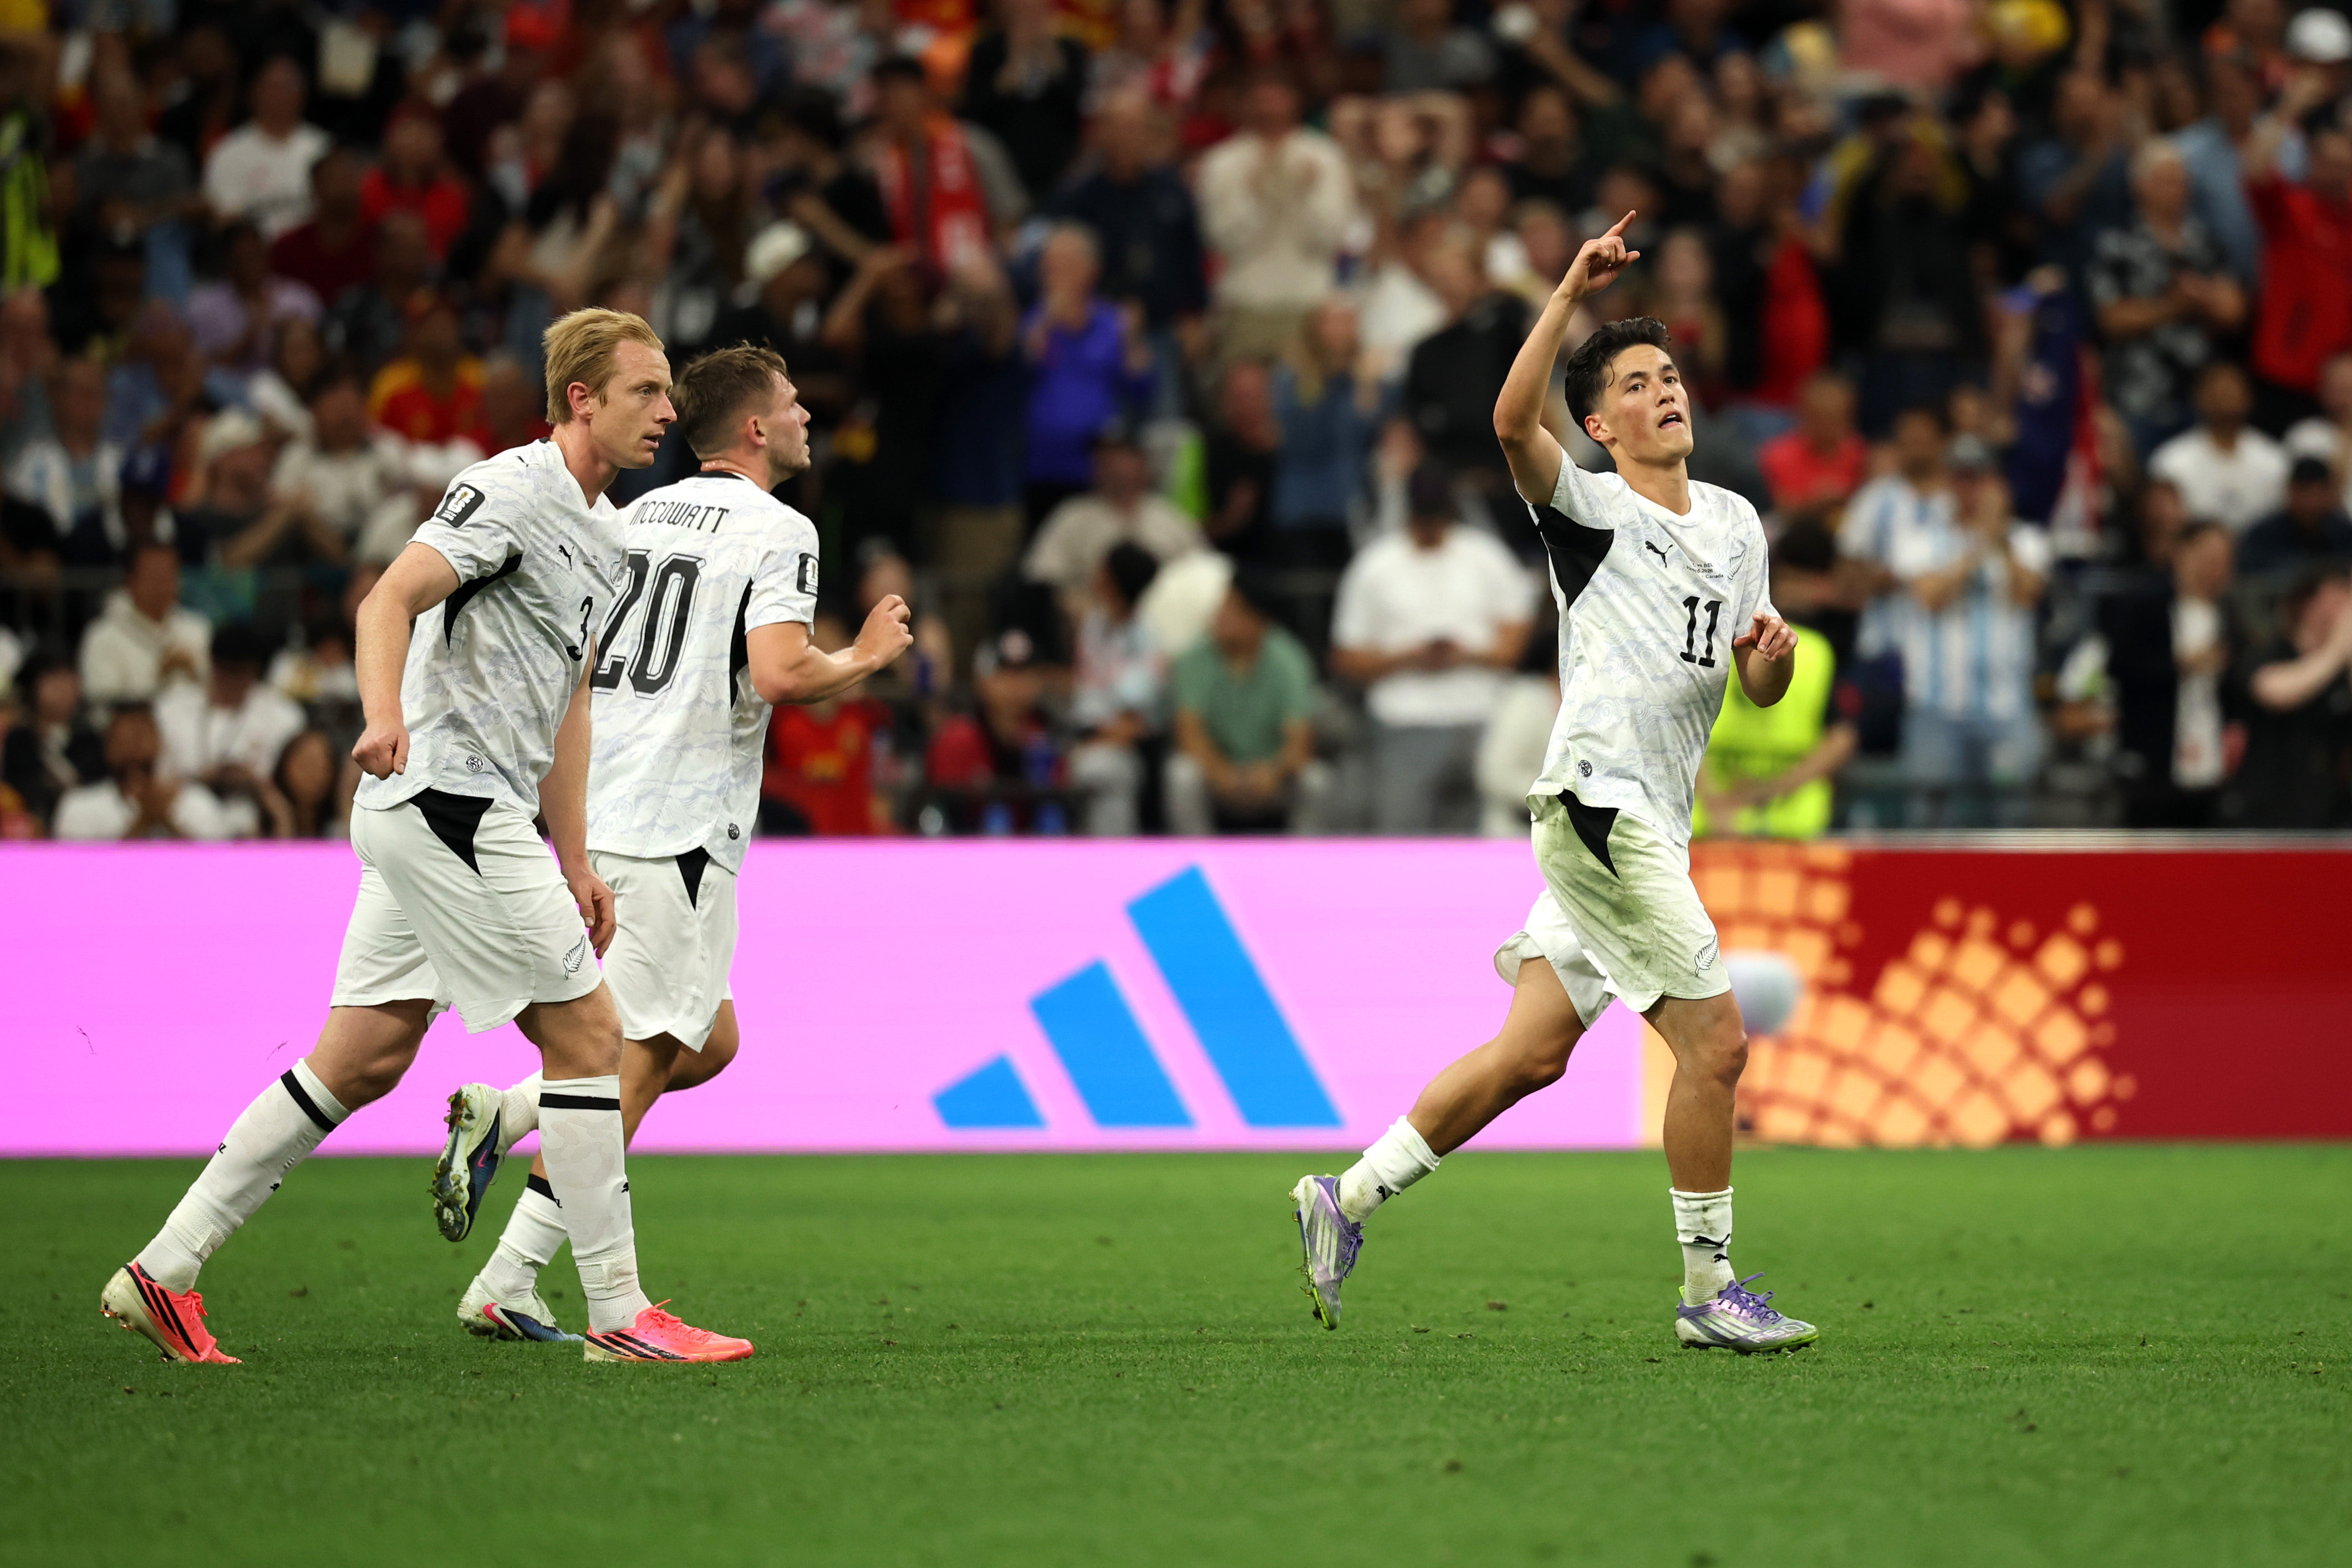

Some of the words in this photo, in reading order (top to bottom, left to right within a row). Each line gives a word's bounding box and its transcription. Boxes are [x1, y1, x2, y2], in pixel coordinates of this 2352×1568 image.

[629, 501, 730, 533] MCCOWATT
[567, 596, 594, 661] 3
[589, 548, 707, 700] 20
[1679, 595, 1723, 668] 11
